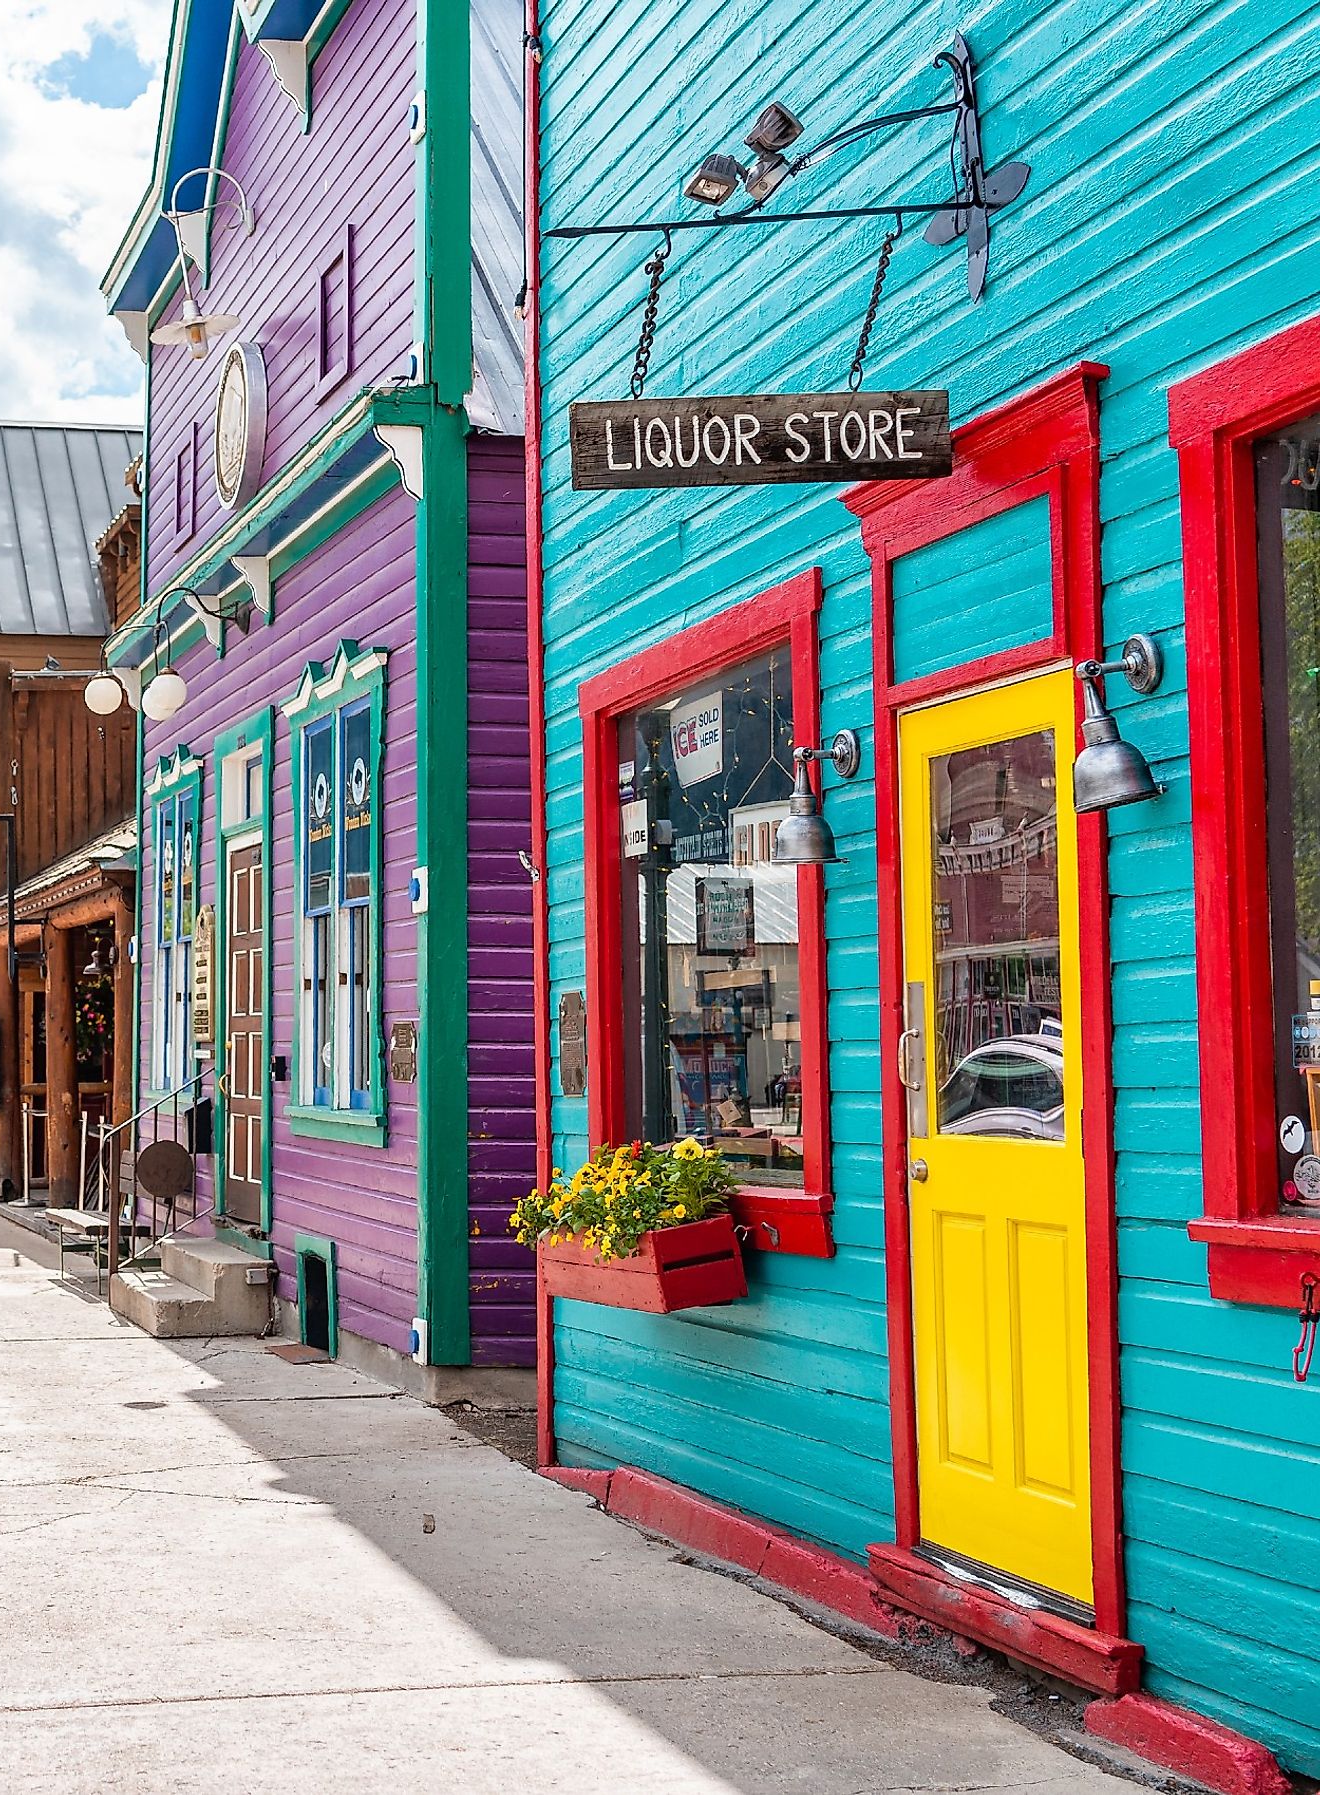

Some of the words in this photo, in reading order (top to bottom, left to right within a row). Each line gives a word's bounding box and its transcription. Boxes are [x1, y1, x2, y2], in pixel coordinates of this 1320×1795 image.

[606, 413, 761, 471] LIQUOR
[785, 407, 923, 464] STORE
[672, 716, 698, 759] ICE
[699, 727, 719, 749] HERE
[698, 707, 719, 727] SOLD
